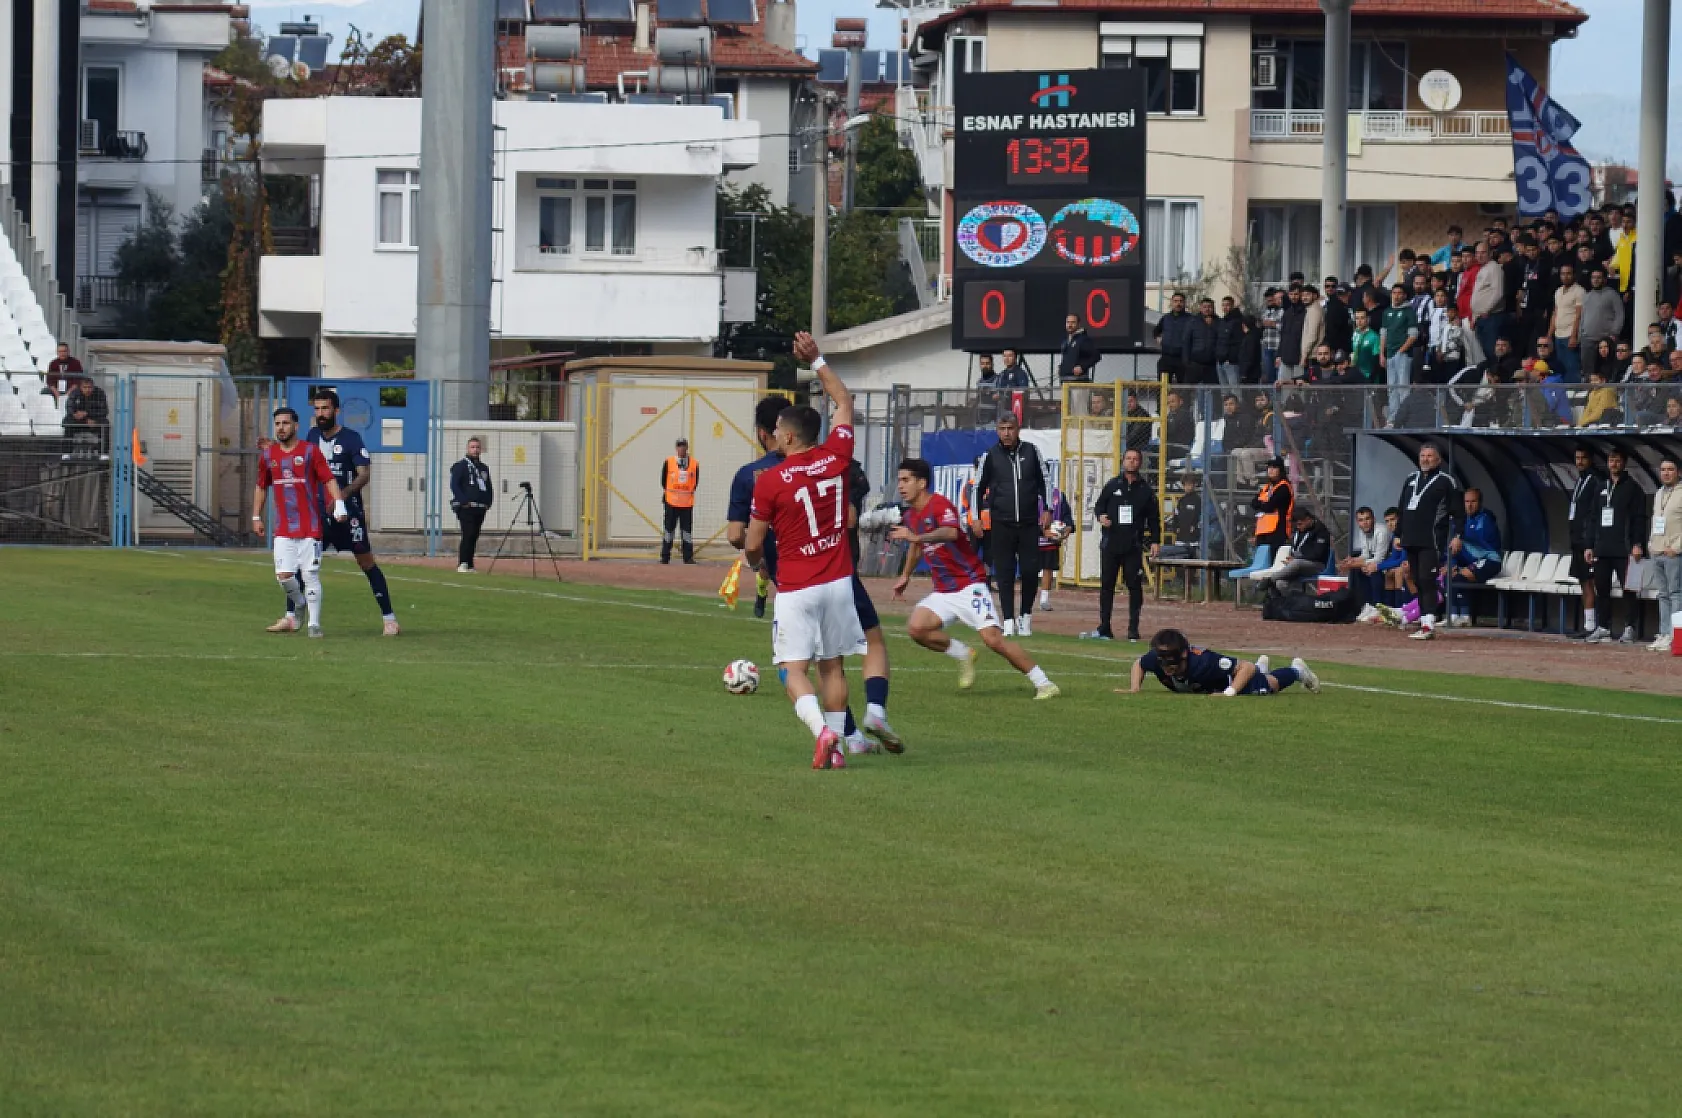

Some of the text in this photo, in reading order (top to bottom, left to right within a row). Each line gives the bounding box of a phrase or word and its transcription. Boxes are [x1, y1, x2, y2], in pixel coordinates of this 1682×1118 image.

[963, 109, 1136, 132] ESNAF HASTANESİ
[1006, 138, 1090, 174] 13:32
[1516, 156, 1592, 216] 33
[981, 290, 1007, 330] 0
[1086, 288, 1111, 329] 0
[794, 474, 844, 538] 17
